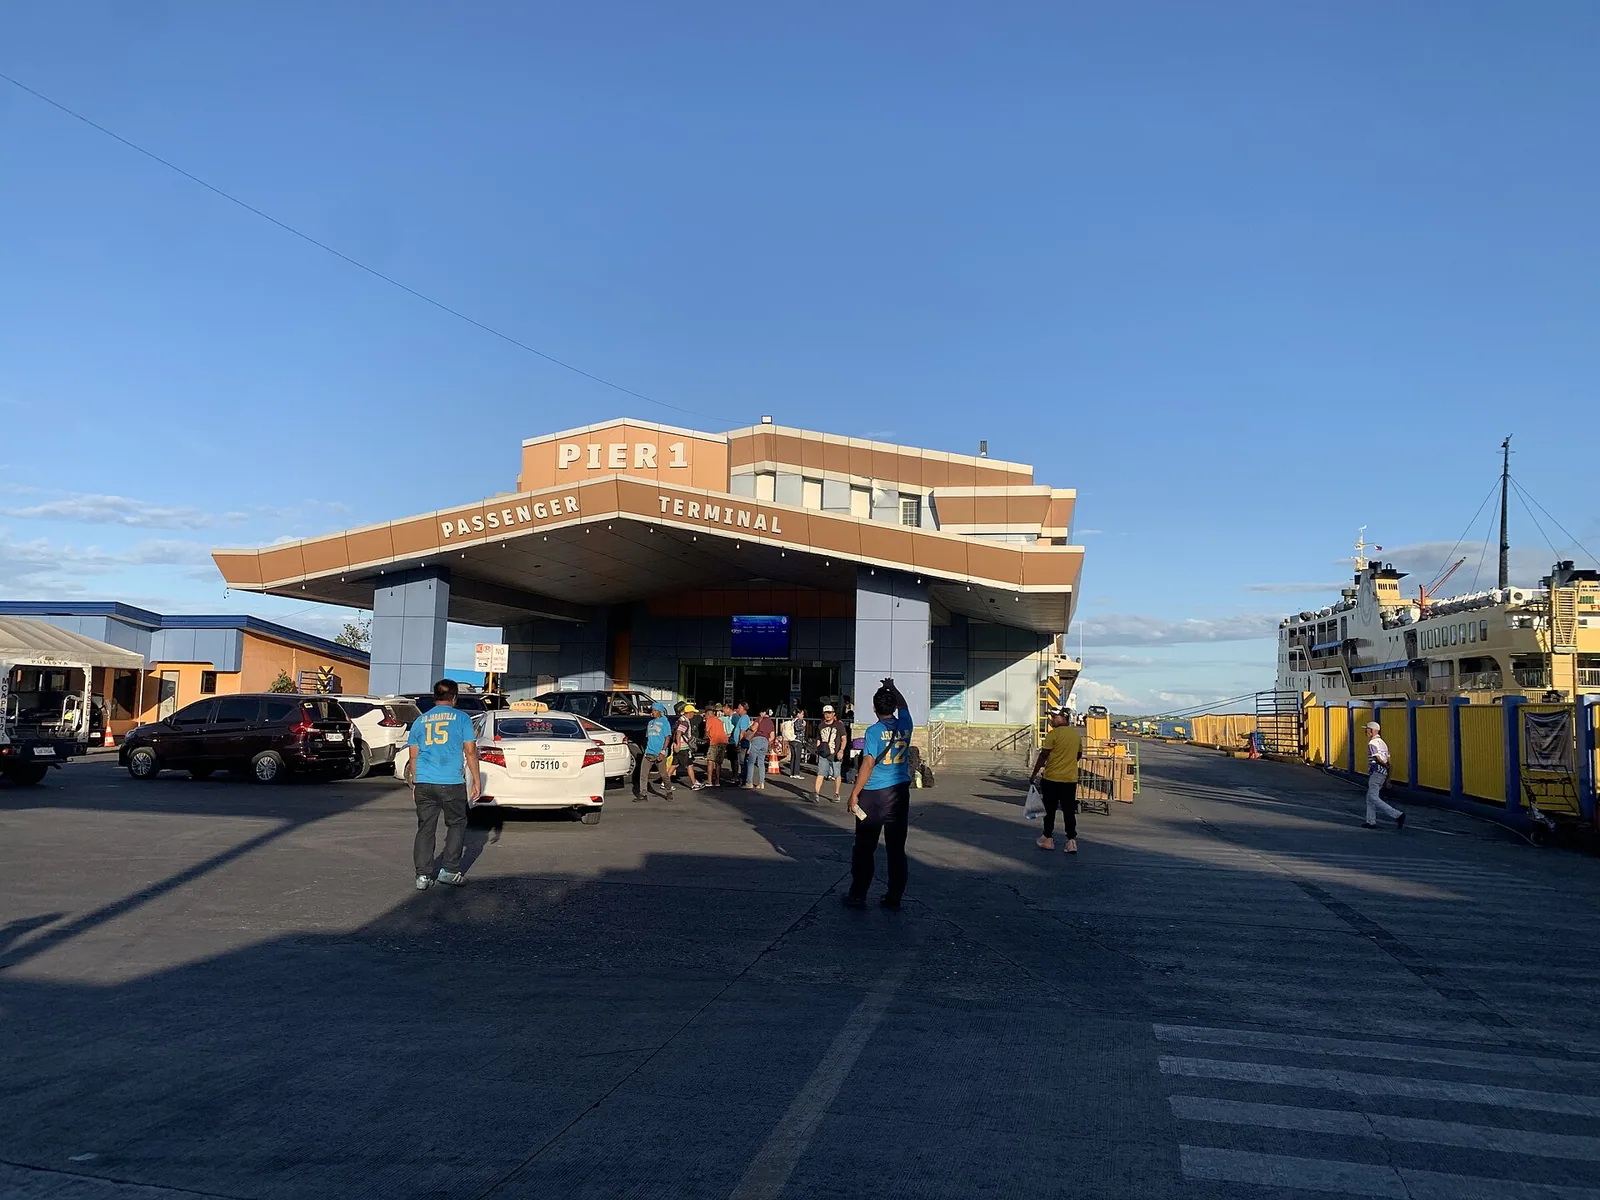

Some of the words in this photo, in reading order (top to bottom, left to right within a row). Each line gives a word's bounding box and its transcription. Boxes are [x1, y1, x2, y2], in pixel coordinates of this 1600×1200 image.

[558, 443, 658, 469] PIER
[668, 442, 688, 468] 1
[441, 495, 580, 539] PASSENGER
[658, 495, 782, 534] TERMINAL
[495, 647, 505, 655] NO
[424, 721, 449, 746] 15
[530, 760, 560, 770] 075110
[882, 741, 908, 765] 12
